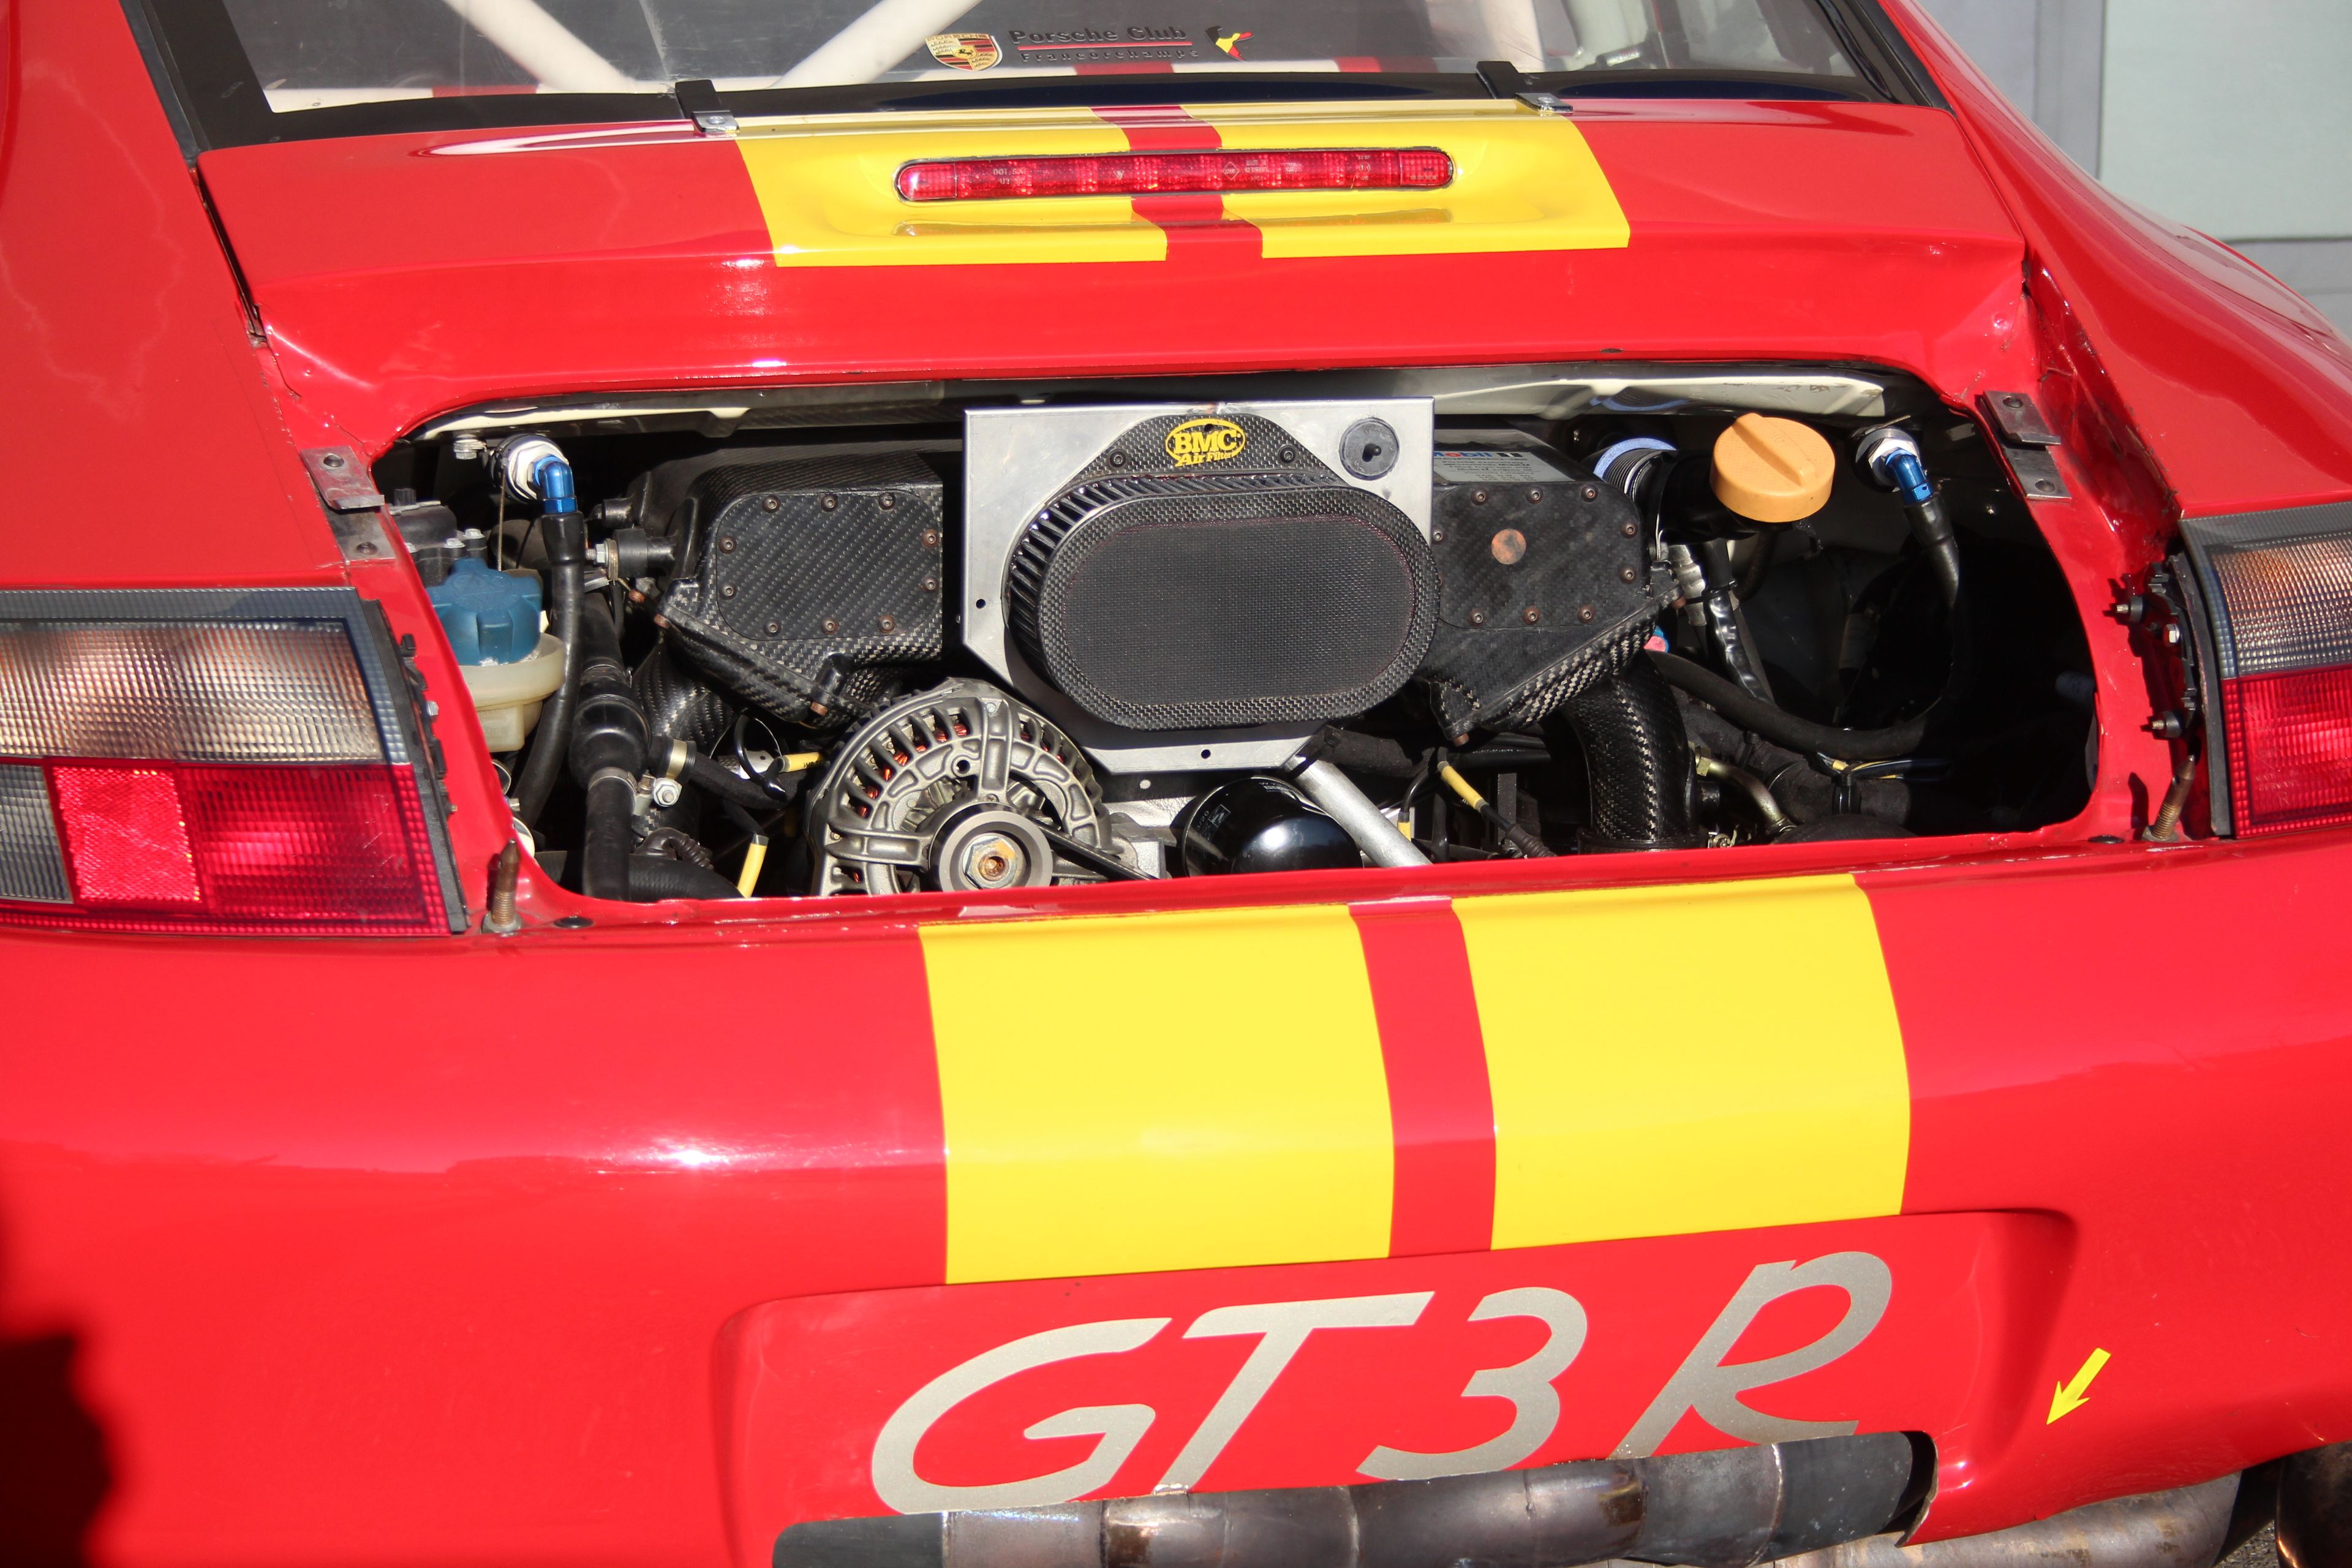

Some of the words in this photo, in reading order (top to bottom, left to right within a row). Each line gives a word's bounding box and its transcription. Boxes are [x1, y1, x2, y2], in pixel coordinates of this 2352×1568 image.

[1008, 28, 1118, 44] Porsche
[1127, 26, 1187, 40] Club
[1020, 50, 1199, 62] Francorchamps
[1173, 429, 1237, 454] BMC
[1175, 453, 1205, 467] Air
[1206, 451, 1232, 462] Filter
[1609, 1251, 1893, 1460] R
